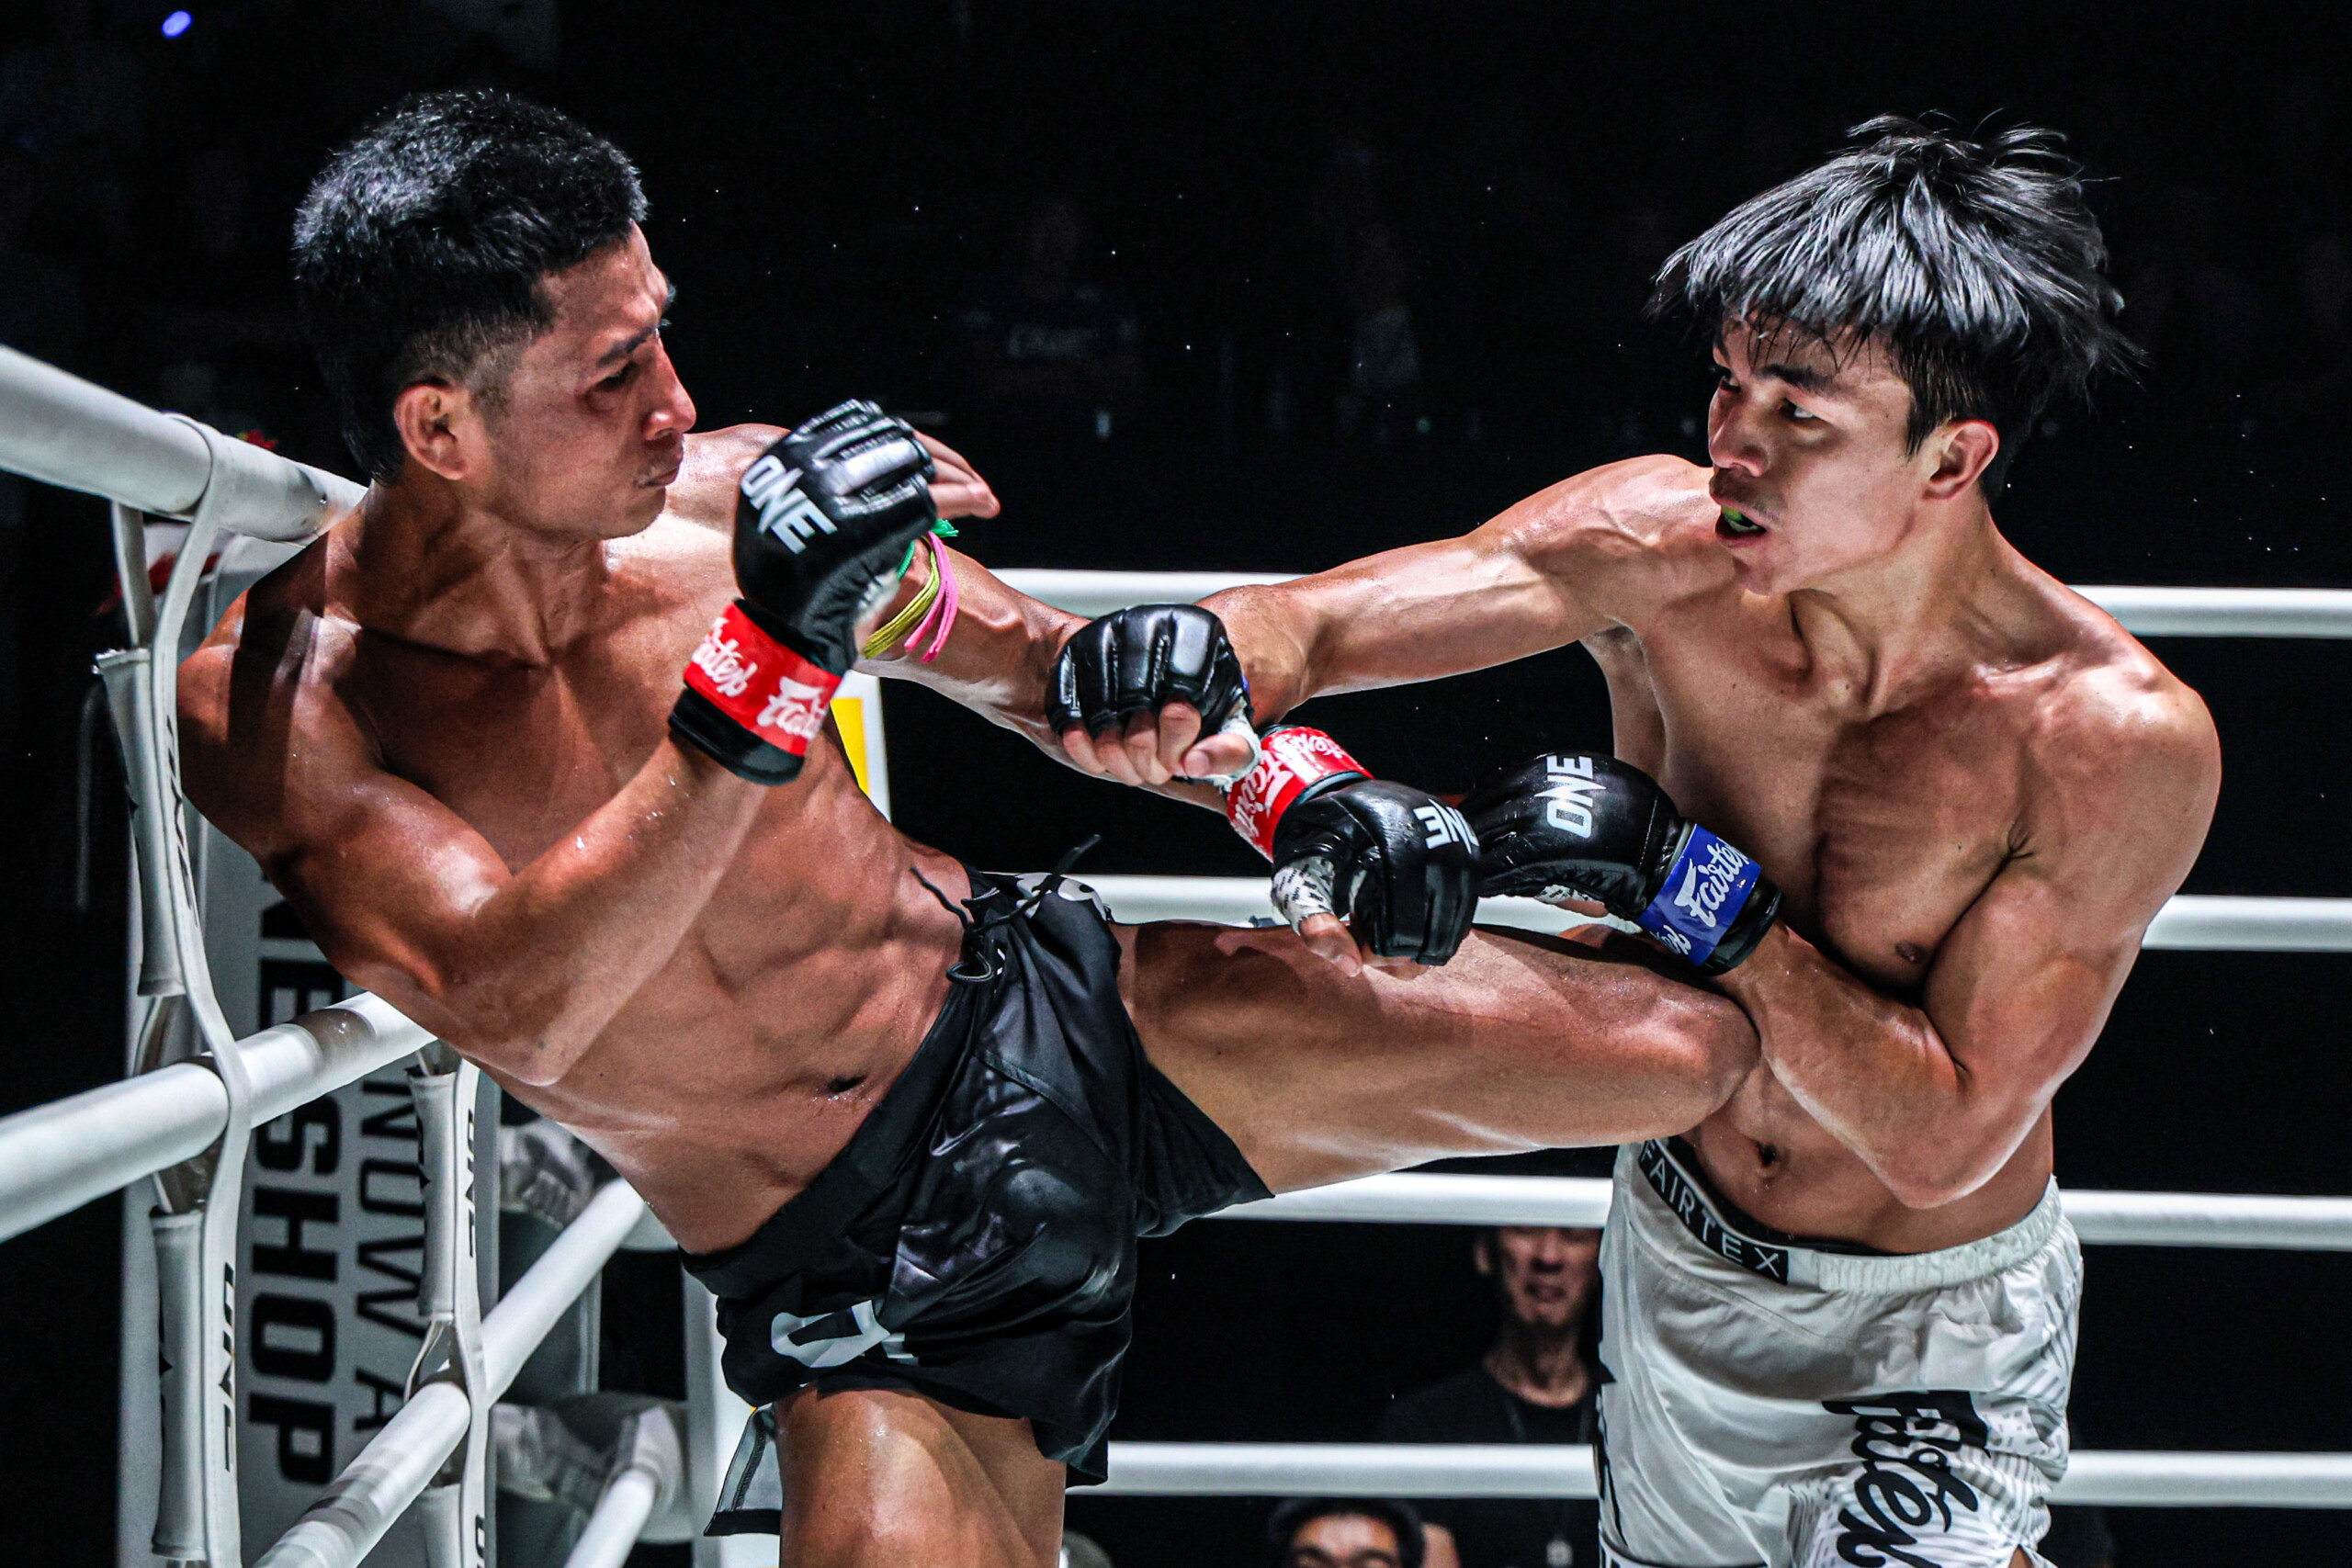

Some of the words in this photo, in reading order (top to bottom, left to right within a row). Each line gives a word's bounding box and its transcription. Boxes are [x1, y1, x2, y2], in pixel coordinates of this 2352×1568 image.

[741, 455, 837, 555] ONE
[1534, 755, 1607, 839] ONE
[1641, 1143, 1781, 1279] FAIRTEX
[248, 1100, 343, 1486] SHOP
